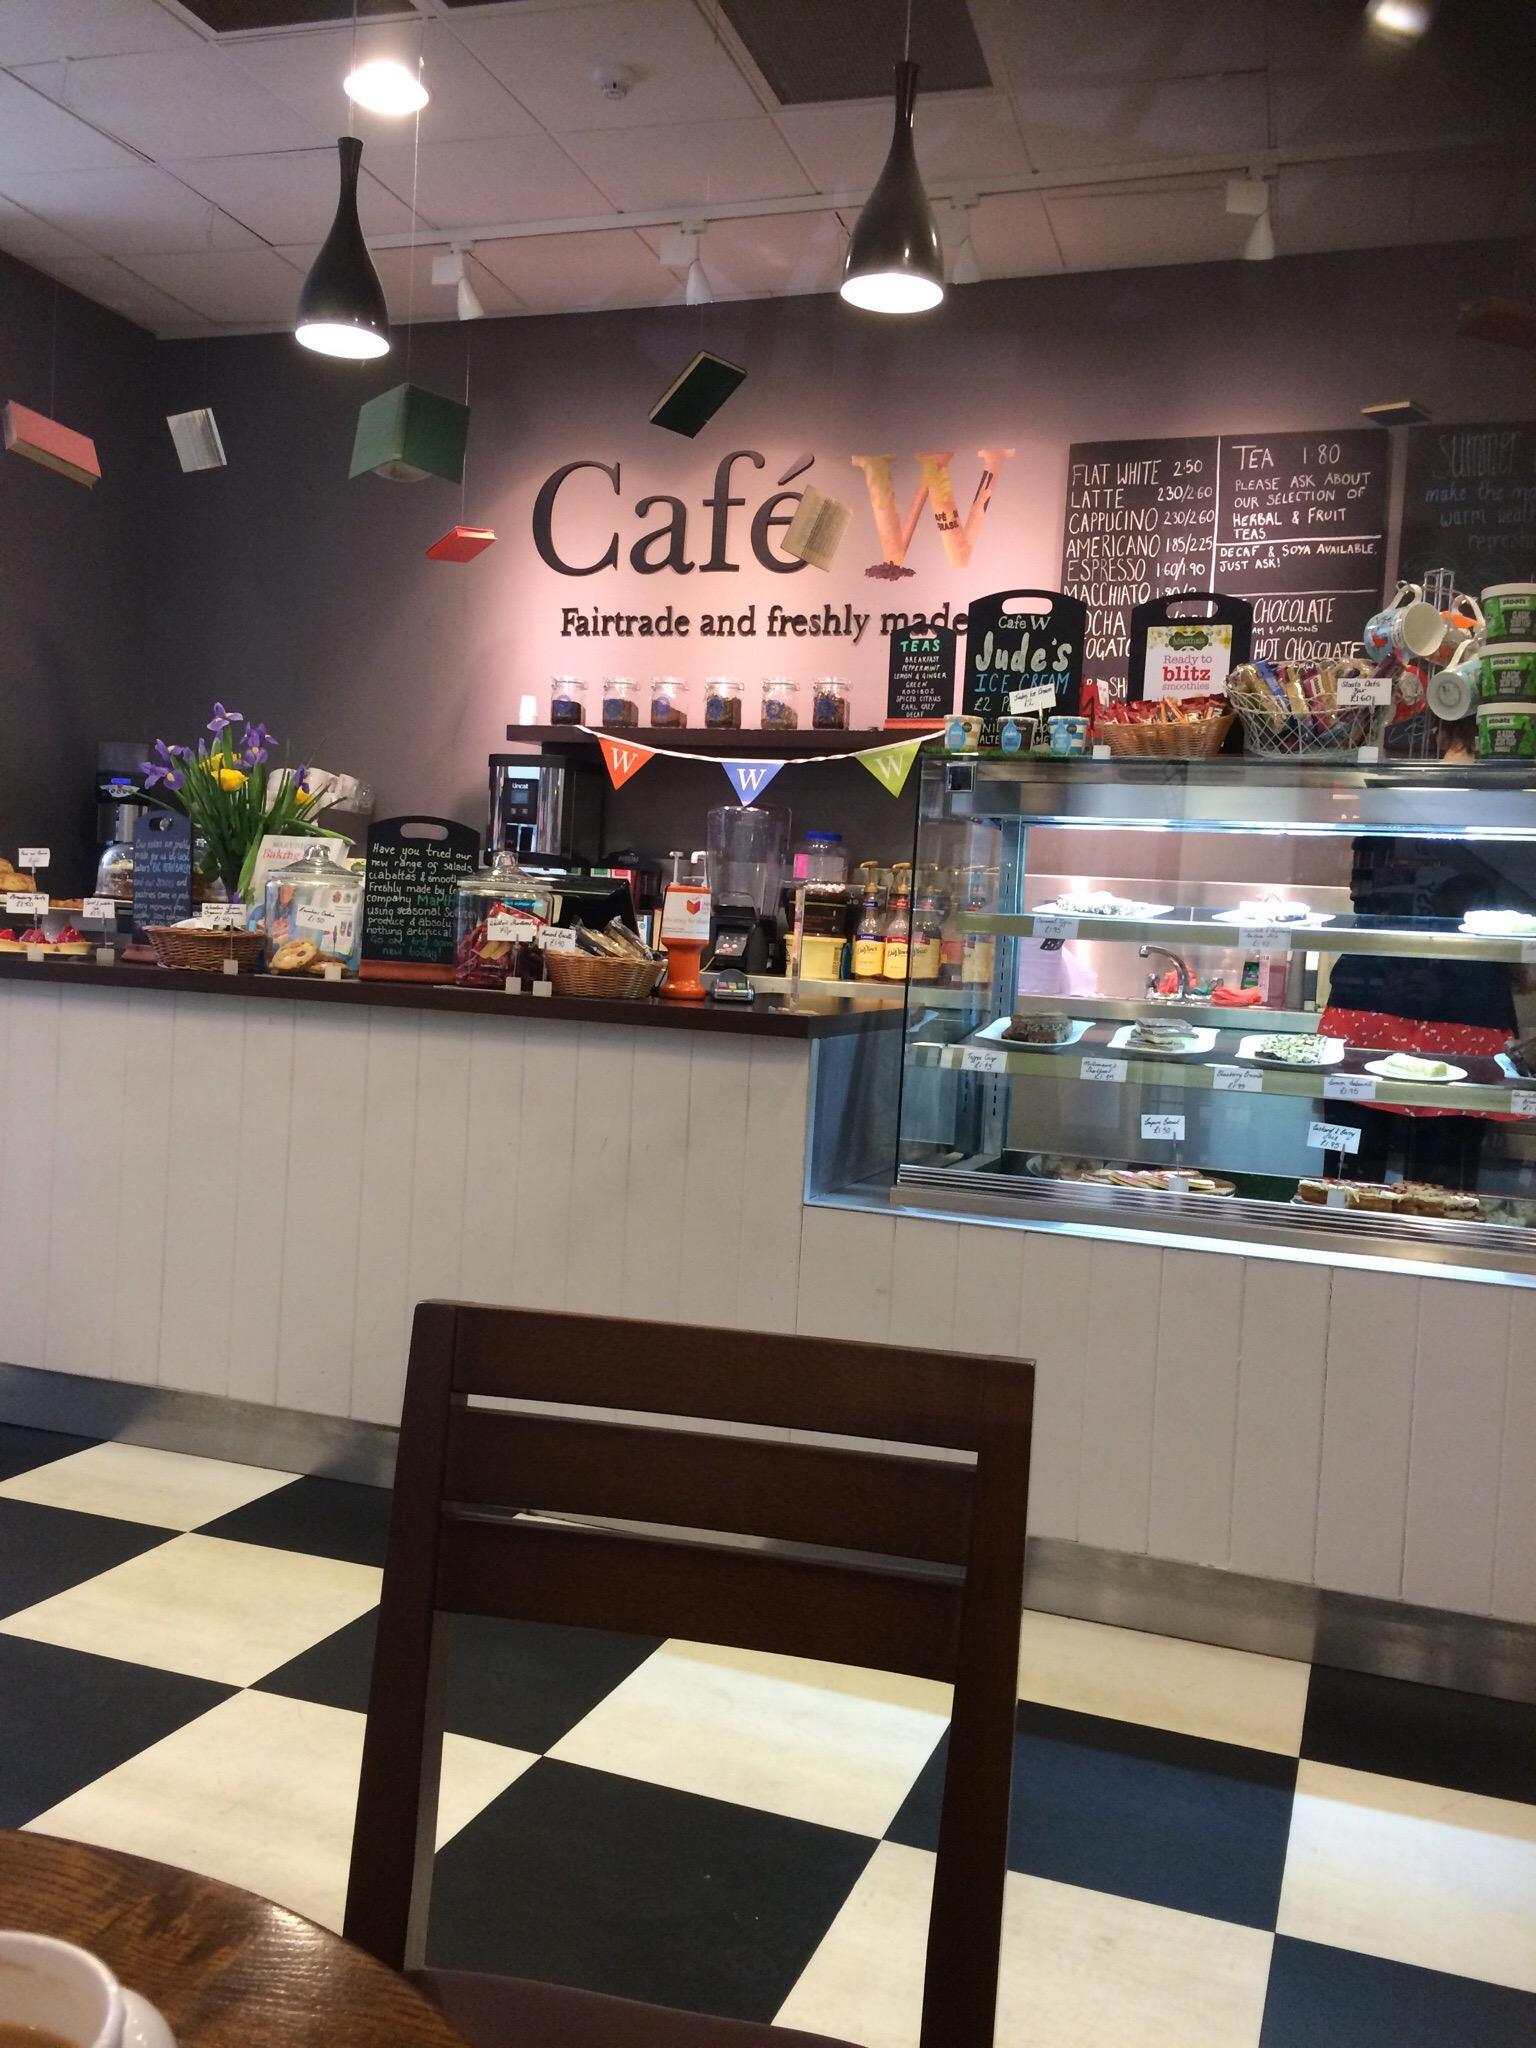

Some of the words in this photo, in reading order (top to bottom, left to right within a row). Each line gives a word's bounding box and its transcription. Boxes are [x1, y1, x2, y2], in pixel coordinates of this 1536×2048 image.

[1232, 445, 1274, 470] TEA
[1072, 464, 1110, 486] FLAT
[1117, 460, 1161, 485] WHITE
[1235, 477, 1281, 492] PLEASE
[1290, 475, 1316, 488] ASK
[1324, 472, 1371, 485] ABOUT
[1071, 488, 1124, 508] LATTE
[1234, 497, 1259, 510] OUR
[1266, 489, 1336, 506] SELECTION
[1347, 486, 1366, 499] OF
[532, 449, 815, 577] Café
[852, 448, 1016, 569] W
[1068, 507, 1159, 534] CAPPUCINO
[1233, 512, 1283, 528] HERBAL
[1291, 511, 1300, 525] &
[1308, 507, 1347, 524] FRUIT
[1233, 528, 1266, 541] TEAS
[1066, 534, 1161, 558] AMERICANO
[1219, 545, 1260, 558] DECAF
[1268, 546, 1276, 558] &
[1282, 544, 1311, 557] SOYA
[1067, 558, 1146, 582] ESPRESSO
[1219, 560, 1249, 572] JUST
[1255, 557, 1281, 569] ASK!
[1064, 582, 1151, 607] MACCHIATO
[1252, 597, 1336, 624] CHOCOLATE
[561, 606, 695, 637] Fairtrade
[700, 604, 756, 637] and
[766, 603, 873, 645] freshly
[879, 603, 969, 637] made
[998, 615, 1027, 629] Cafe
[1030, 616, 1051, 631] W
[900, 639, 940, 653] TEAS
[975, 631, 1073, 673] Jude's
[1254, 638, 1280, 660] HOT
[1284, 637, 1365, 661] CHOCOLATE
[1164, 655, 1198, 666] Ready
[1201, 655, 1212, 664] to
[1162, 665, 1211, 682] blitz
[975, 674, 1011, 693] ICE
[1161, 682, 1210, 690] smoothies
[901, 703, 918, 711] EARL
[974, 696, 992, 712] £2
[611, 747, 638, 773] W
[876, 750, 905, 780] W
[736, 768, 767, 791] W
[373, 843, 396, 855] Have
[400, 846, 420, 860] you
[425, 844, 451, 859] tried
[371, 859, 388, 867] new
[394, 860, 422, 873] range
[427, 862, 439, 874] of
[443, 863, 473, 874] salads
[369, 881, 402, 898] Freshly
[406, 885, 431, 894] made
[434, 885, 446, 897] by
[366, 894, 412, 907] company
[367, 907, 394, 918] using
[397, 907, 442, 916] seasonal
[368, 918, 404, 929] produce
[366, 928, 403, 943] nothing
